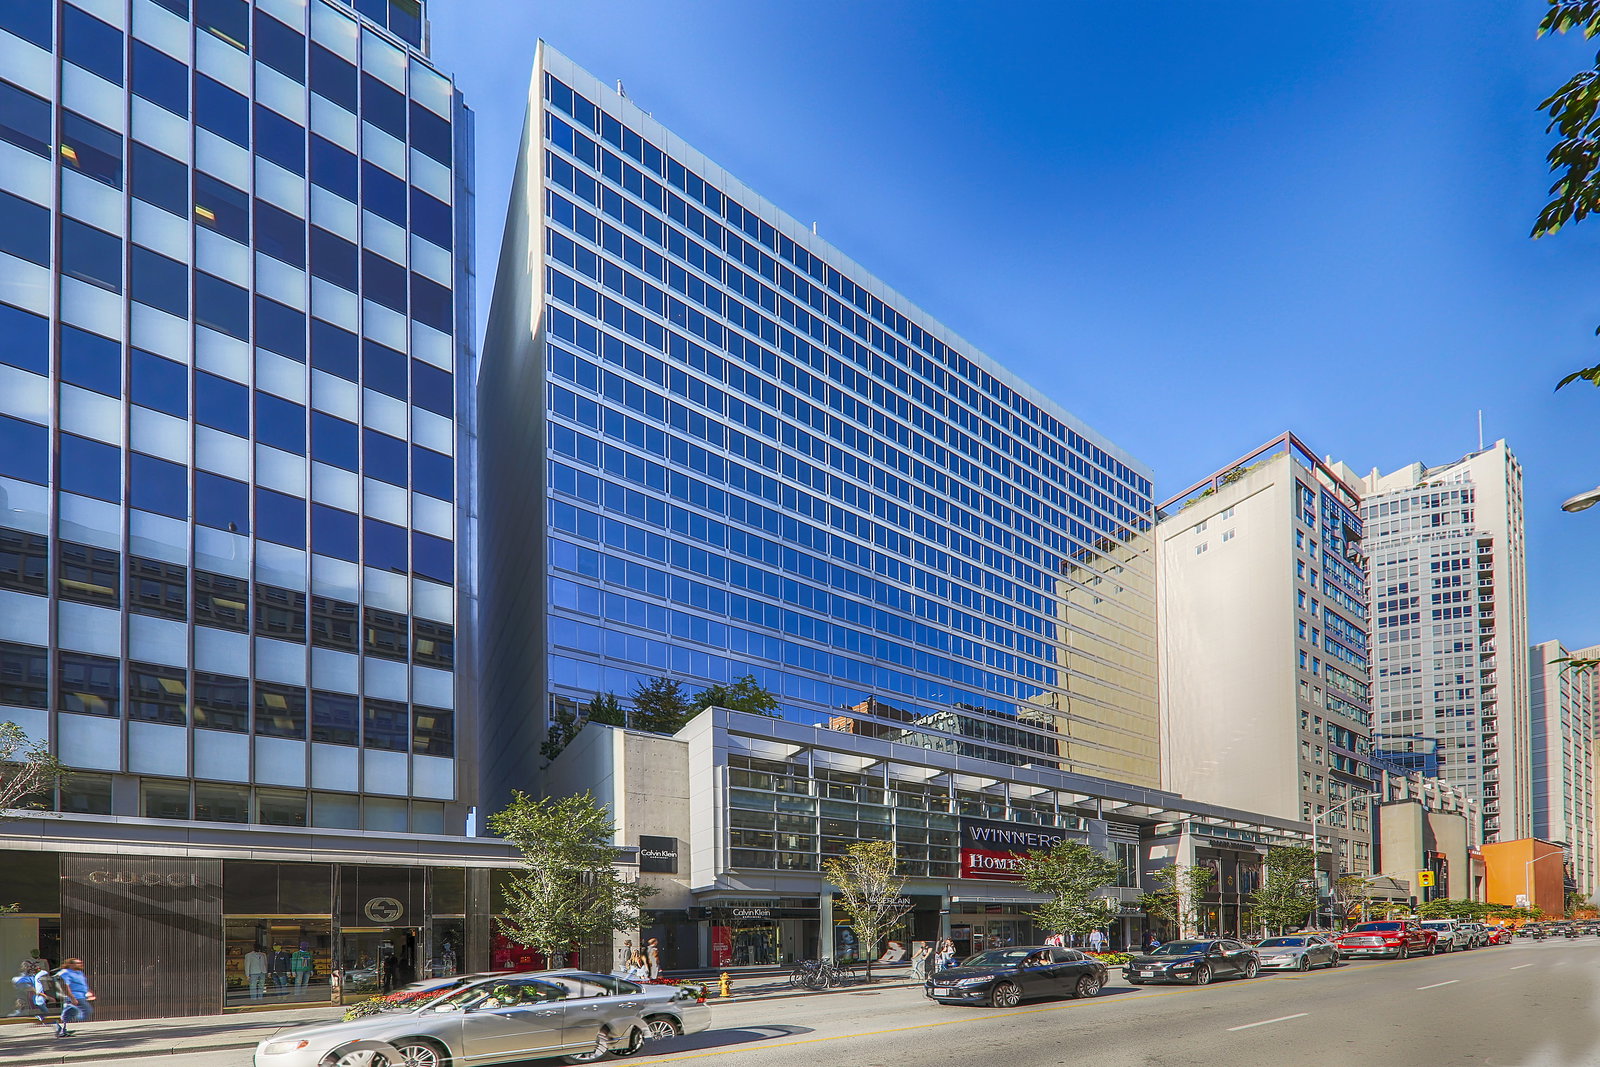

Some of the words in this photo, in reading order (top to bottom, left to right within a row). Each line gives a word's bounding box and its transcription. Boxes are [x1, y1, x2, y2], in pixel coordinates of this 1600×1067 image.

[969, 826, 1062, 847] WINNERS
[641, 849, 661, 857] Calvin
[662, 850, 677, 858] Klein
[89, 870, 198, 887] GUCCI
[733, 908, 754, 916] Calvin
[755, 908, 770, 917] Klein
